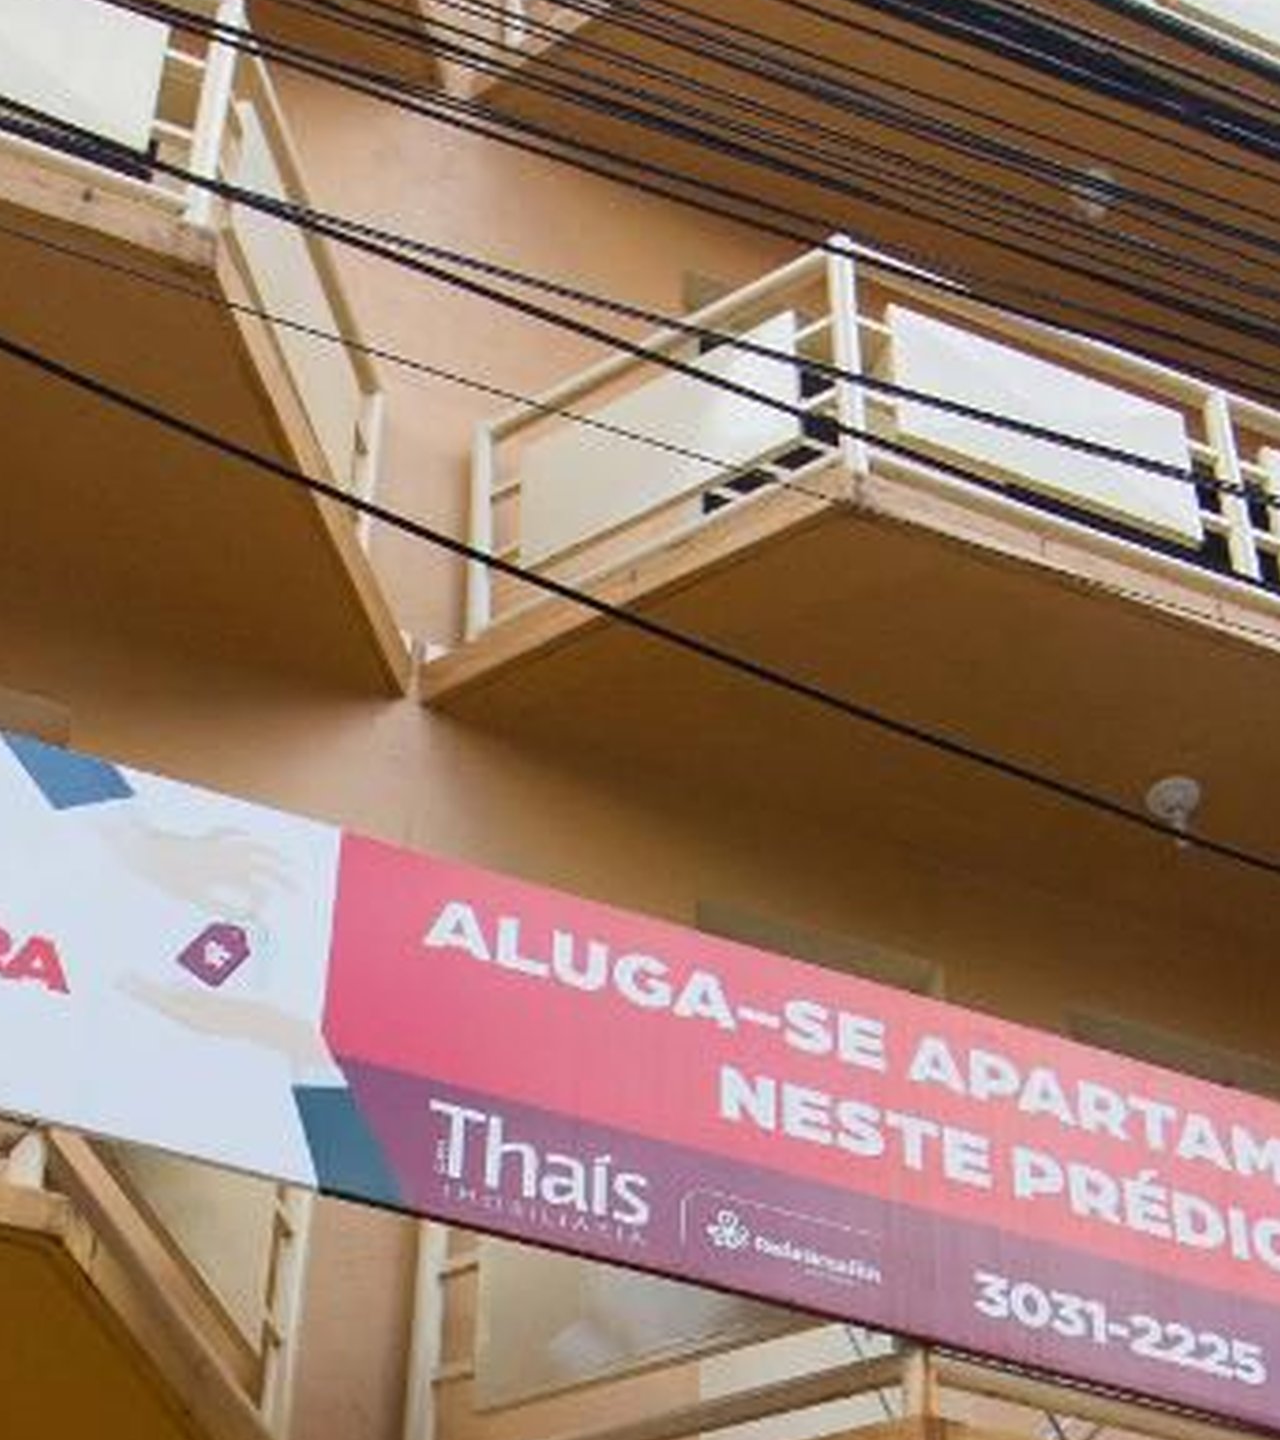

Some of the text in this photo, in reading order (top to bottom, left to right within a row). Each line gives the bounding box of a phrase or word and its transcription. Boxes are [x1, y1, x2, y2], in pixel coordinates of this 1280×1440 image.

[424, 901, 886, 1071] ALUGA-SE
[429, 1098, 651, 1226] Thaís
[720, 1067, 992, 1187] NESTE
[973, 1272, 1266, 1386] 3031-2225
